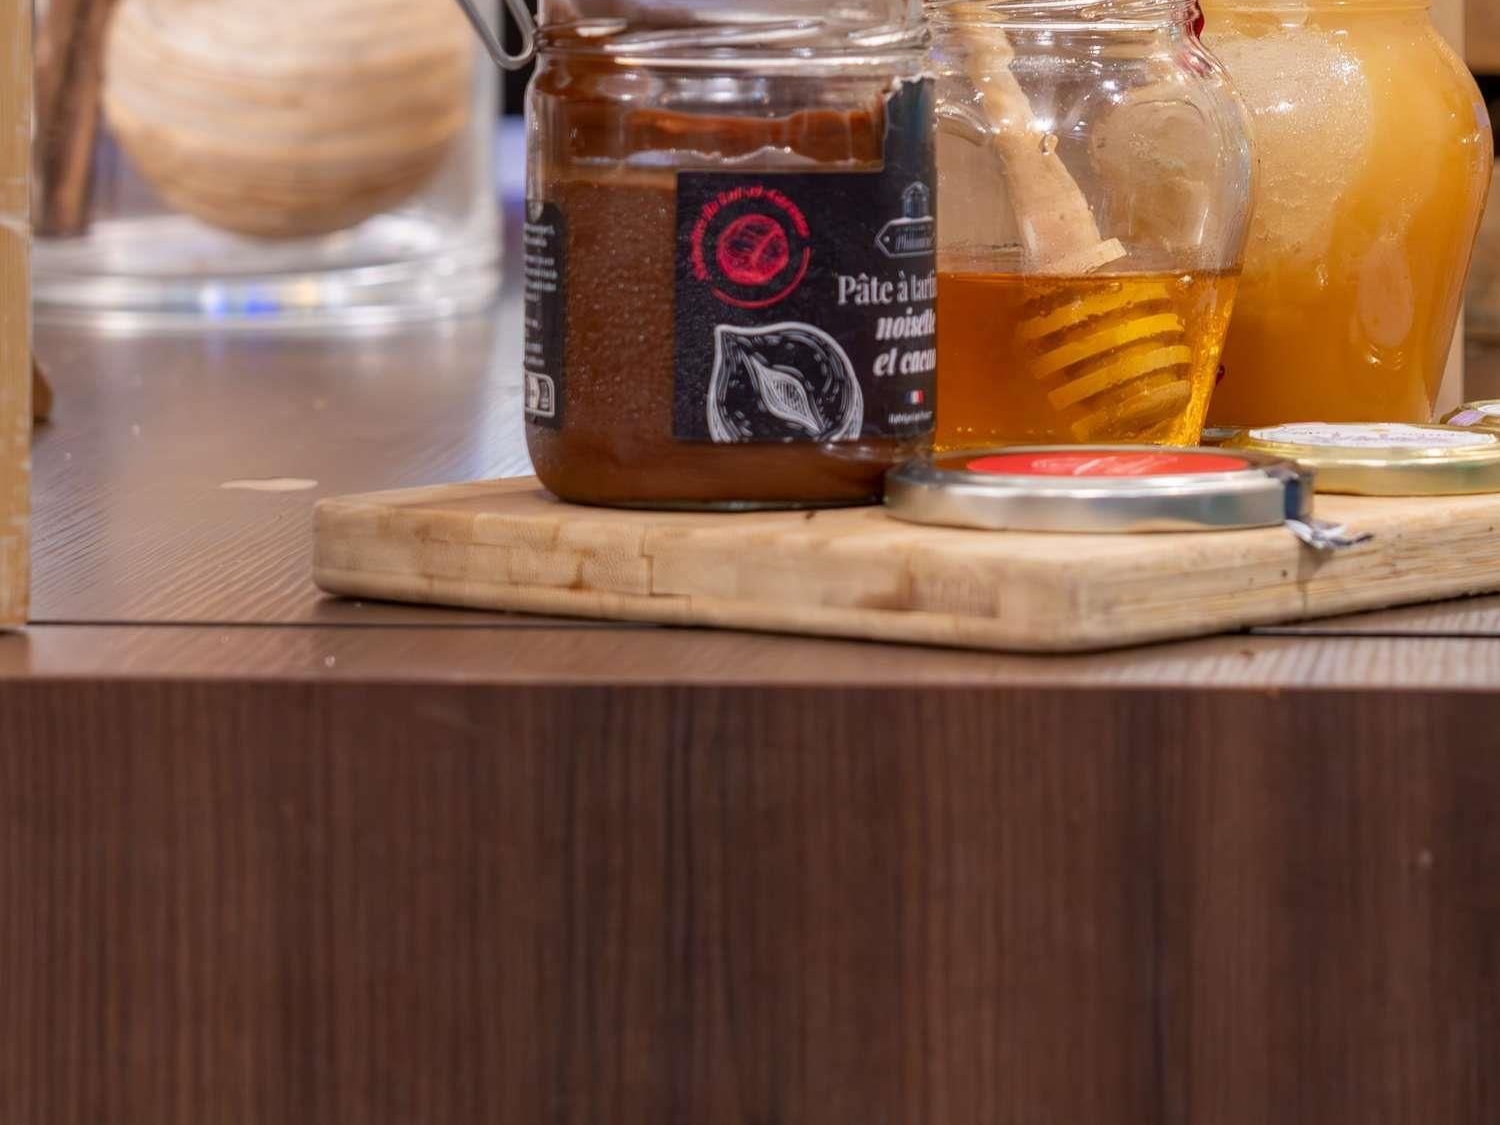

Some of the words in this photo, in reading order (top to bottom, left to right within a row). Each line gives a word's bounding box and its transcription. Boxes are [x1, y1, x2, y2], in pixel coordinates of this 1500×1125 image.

[838, 272, 893, 305] Pâte
[897, 269, 909, 302] à
[873, 347, 898, 376] et
